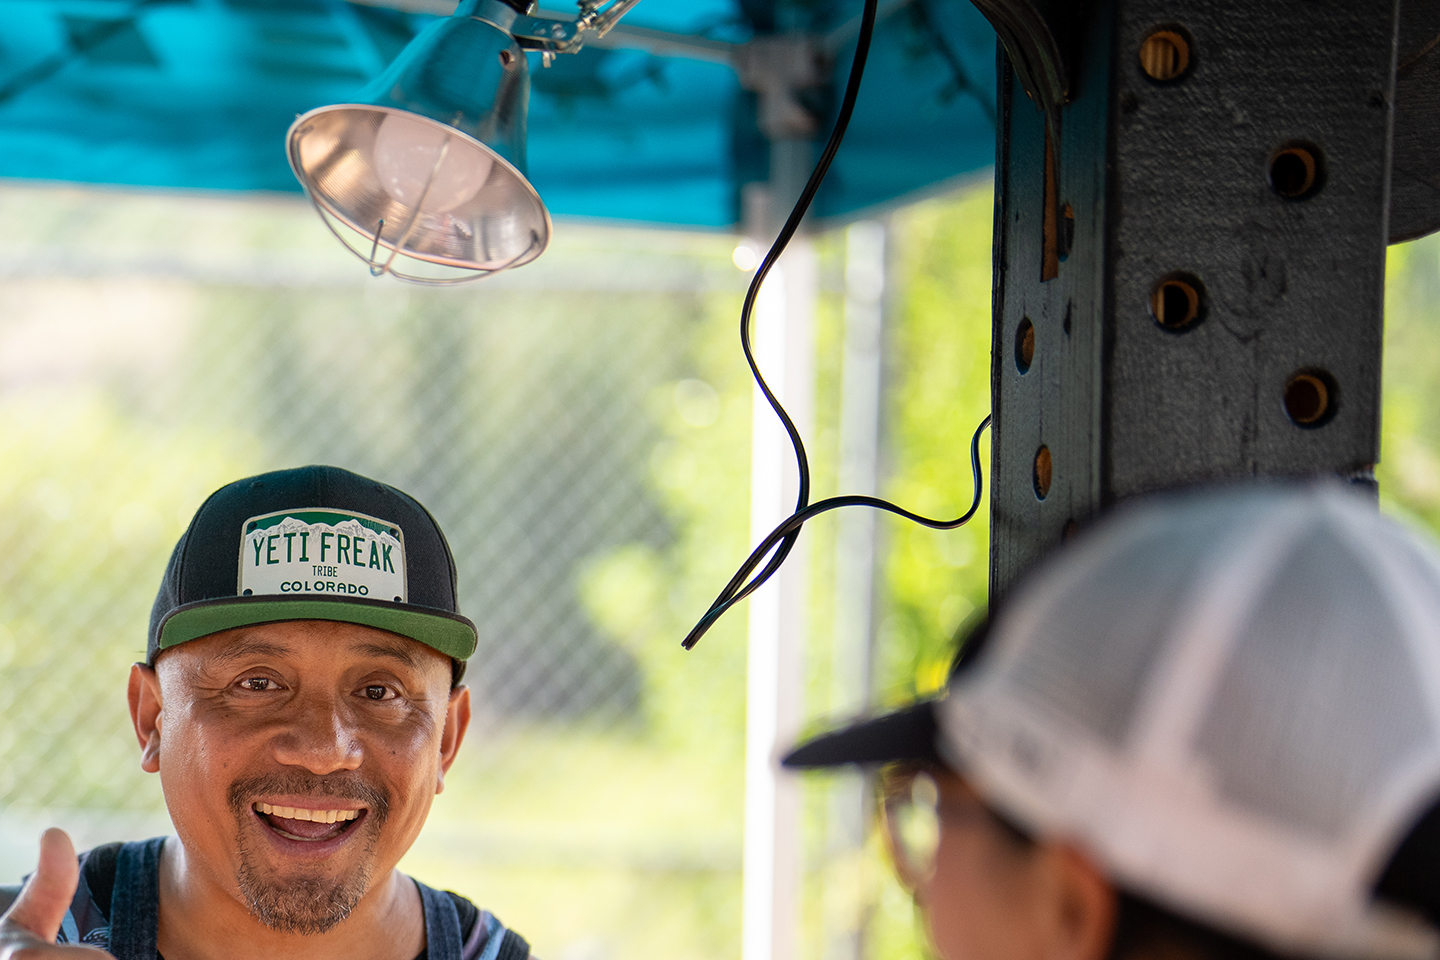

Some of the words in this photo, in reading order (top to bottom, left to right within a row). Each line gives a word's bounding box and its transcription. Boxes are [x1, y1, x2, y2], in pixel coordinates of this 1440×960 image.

[253, 532, 310, 566] YETI
[320, 532, 395, 574] FREAK
[312, 565, 338, 577] TRIBE
[280, 581, 369, 596] COLORADO
